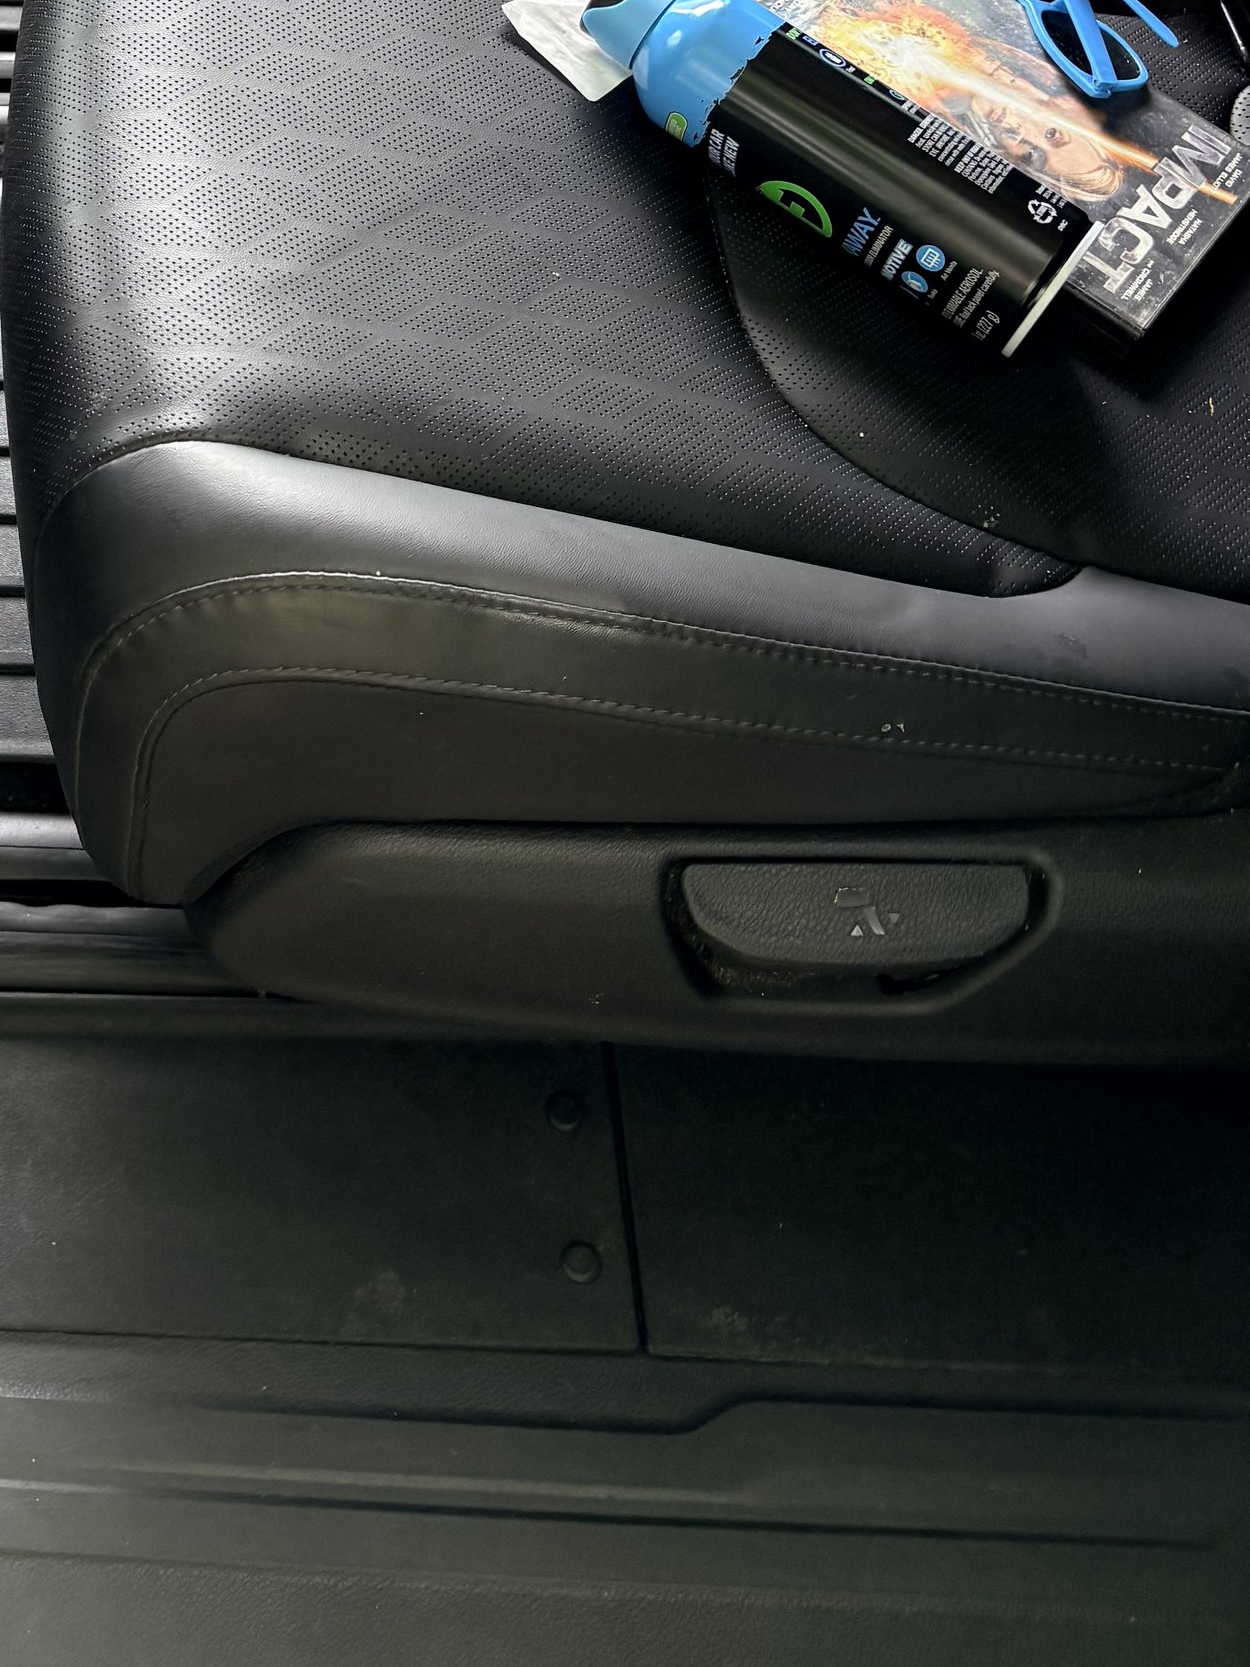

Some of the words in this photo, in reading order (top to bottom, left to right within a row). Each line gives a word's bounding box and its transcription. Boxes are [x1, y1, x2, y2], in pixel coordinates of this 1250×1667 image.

[708, 127, 725, 150] CAR
[722, 135, 740, 162] NEW
[1223, 151, 1242, 173] JAMES
[1223, 166, 1243, 189] DAVID
[1081, 123, 1231, 295] IMPACT
[840, 206, 881, 256] AWAY
[868, 224, 894, 258] ELIMINATOR
[1164, 207, 1198, 245] HENSTRIDGE
[1176, 216, 1202, 247] NATASHA
[957, 263, 984, 295] AEROSOL.
[1119, 266, 1151, 302] CROMWELL
[1132, 277, 1154, 302] JAMES
[969, 287, 986, 305] panel
